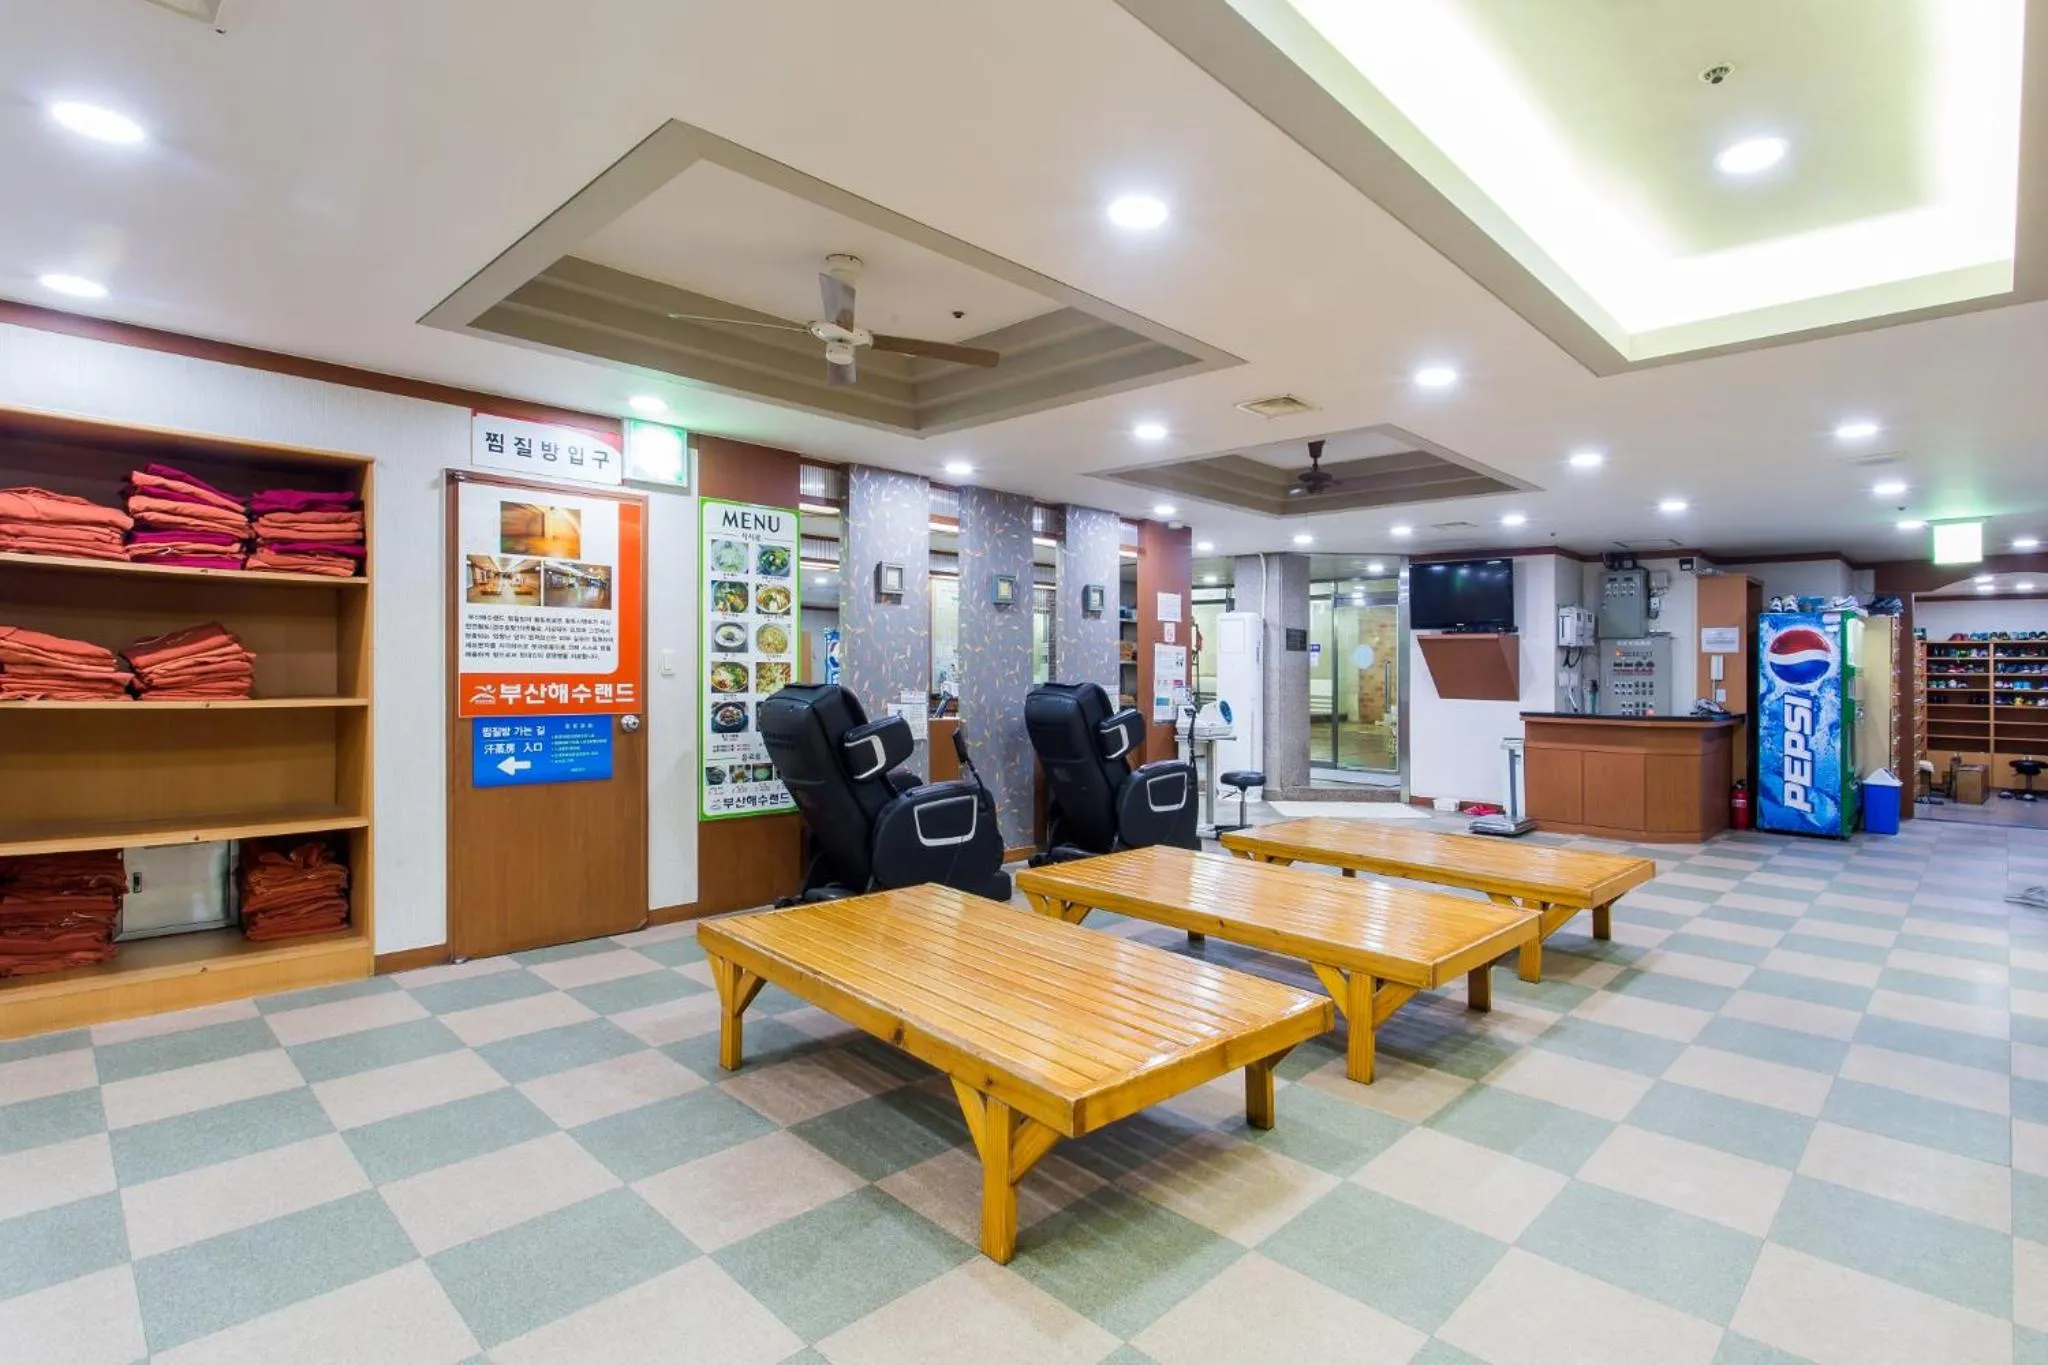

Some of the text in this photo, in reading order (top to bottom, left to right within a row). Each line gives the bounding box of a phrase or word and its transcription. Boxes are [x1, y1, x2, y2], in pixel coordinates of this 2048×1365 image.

[722, 509, 780, 533] MENU
[499, 682, 635, 705] 부산해수랜드
[513, 725, 533, 737] 가는
[535, 725, 545, 736] 길
[522, 741, 543, 753] 入口
[1783, 693, 1813, 813] PEPSI
